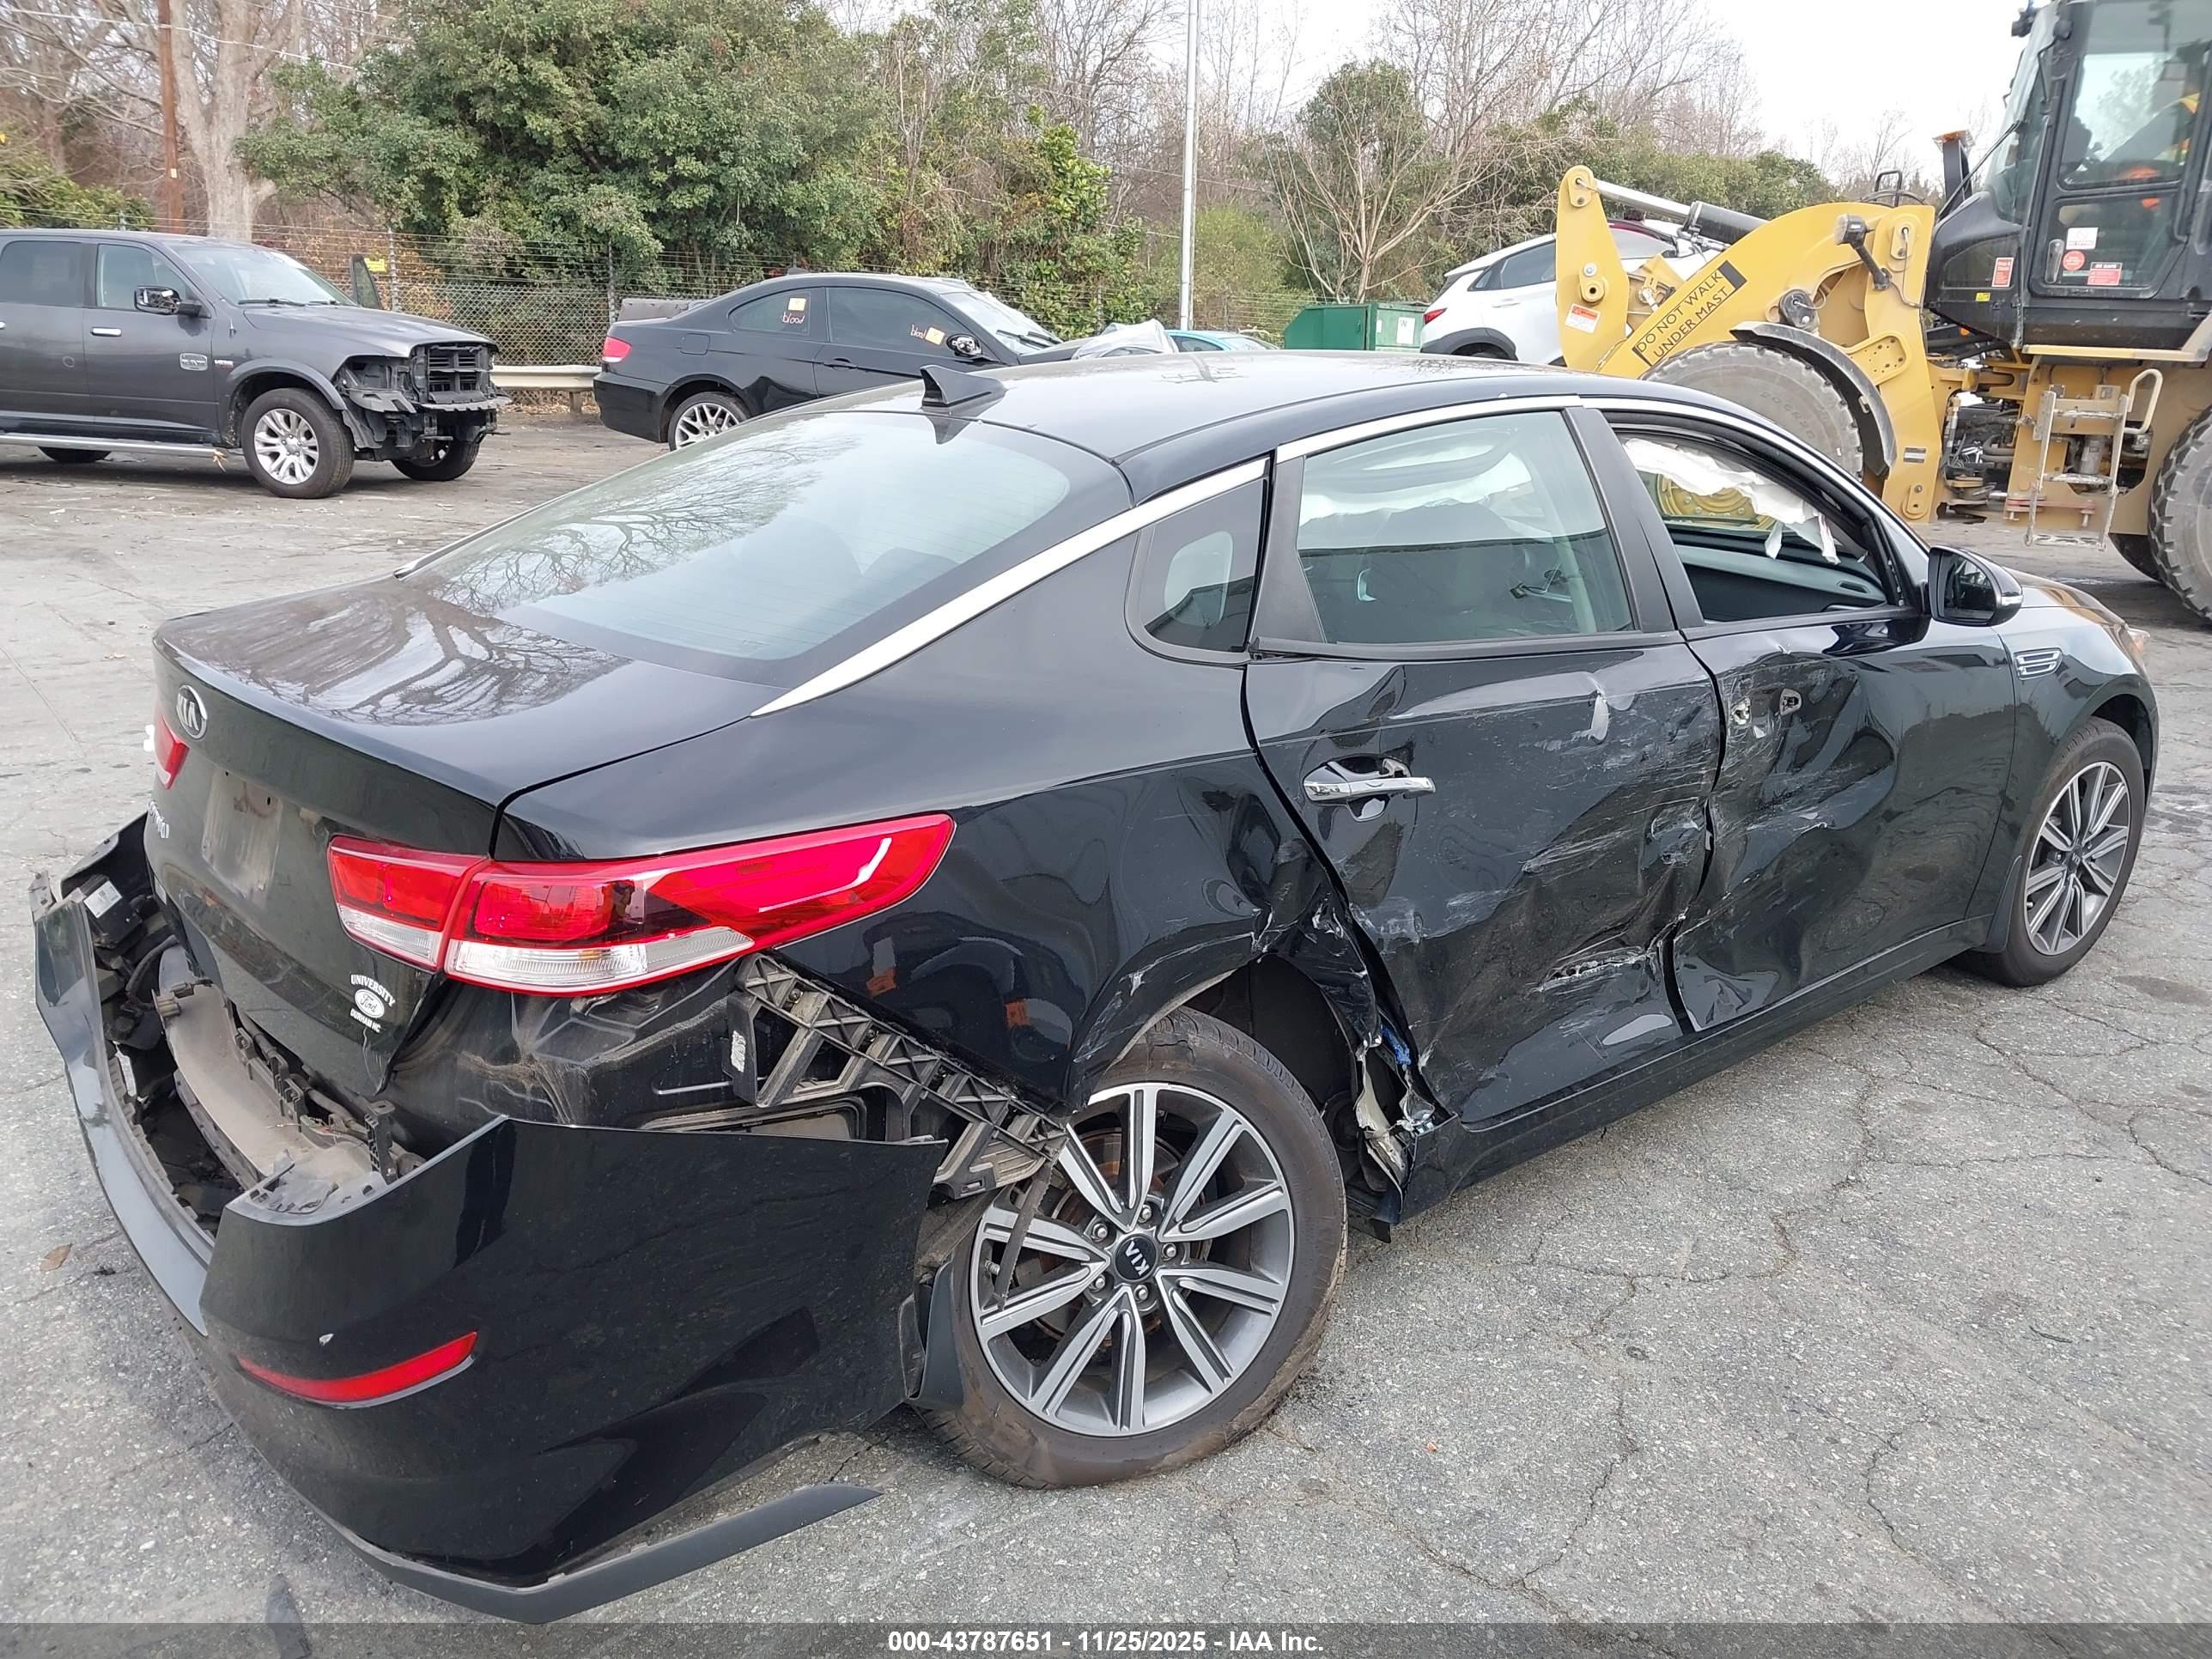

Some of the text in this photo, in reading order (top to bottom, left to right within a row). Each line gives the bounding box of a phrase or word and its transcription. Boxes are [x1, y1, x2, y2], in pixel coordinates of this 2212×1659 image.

[1636, 271, 1723, 353] DO NOT WALK
[1654, 286, 1729, 357] UNDER MAST
[350, 974, 396, 1007] UNIVERSITY
[350, 1008, 382, 1033] DURHAM NC
[1125, 1240, 1150, 1277] KIA
